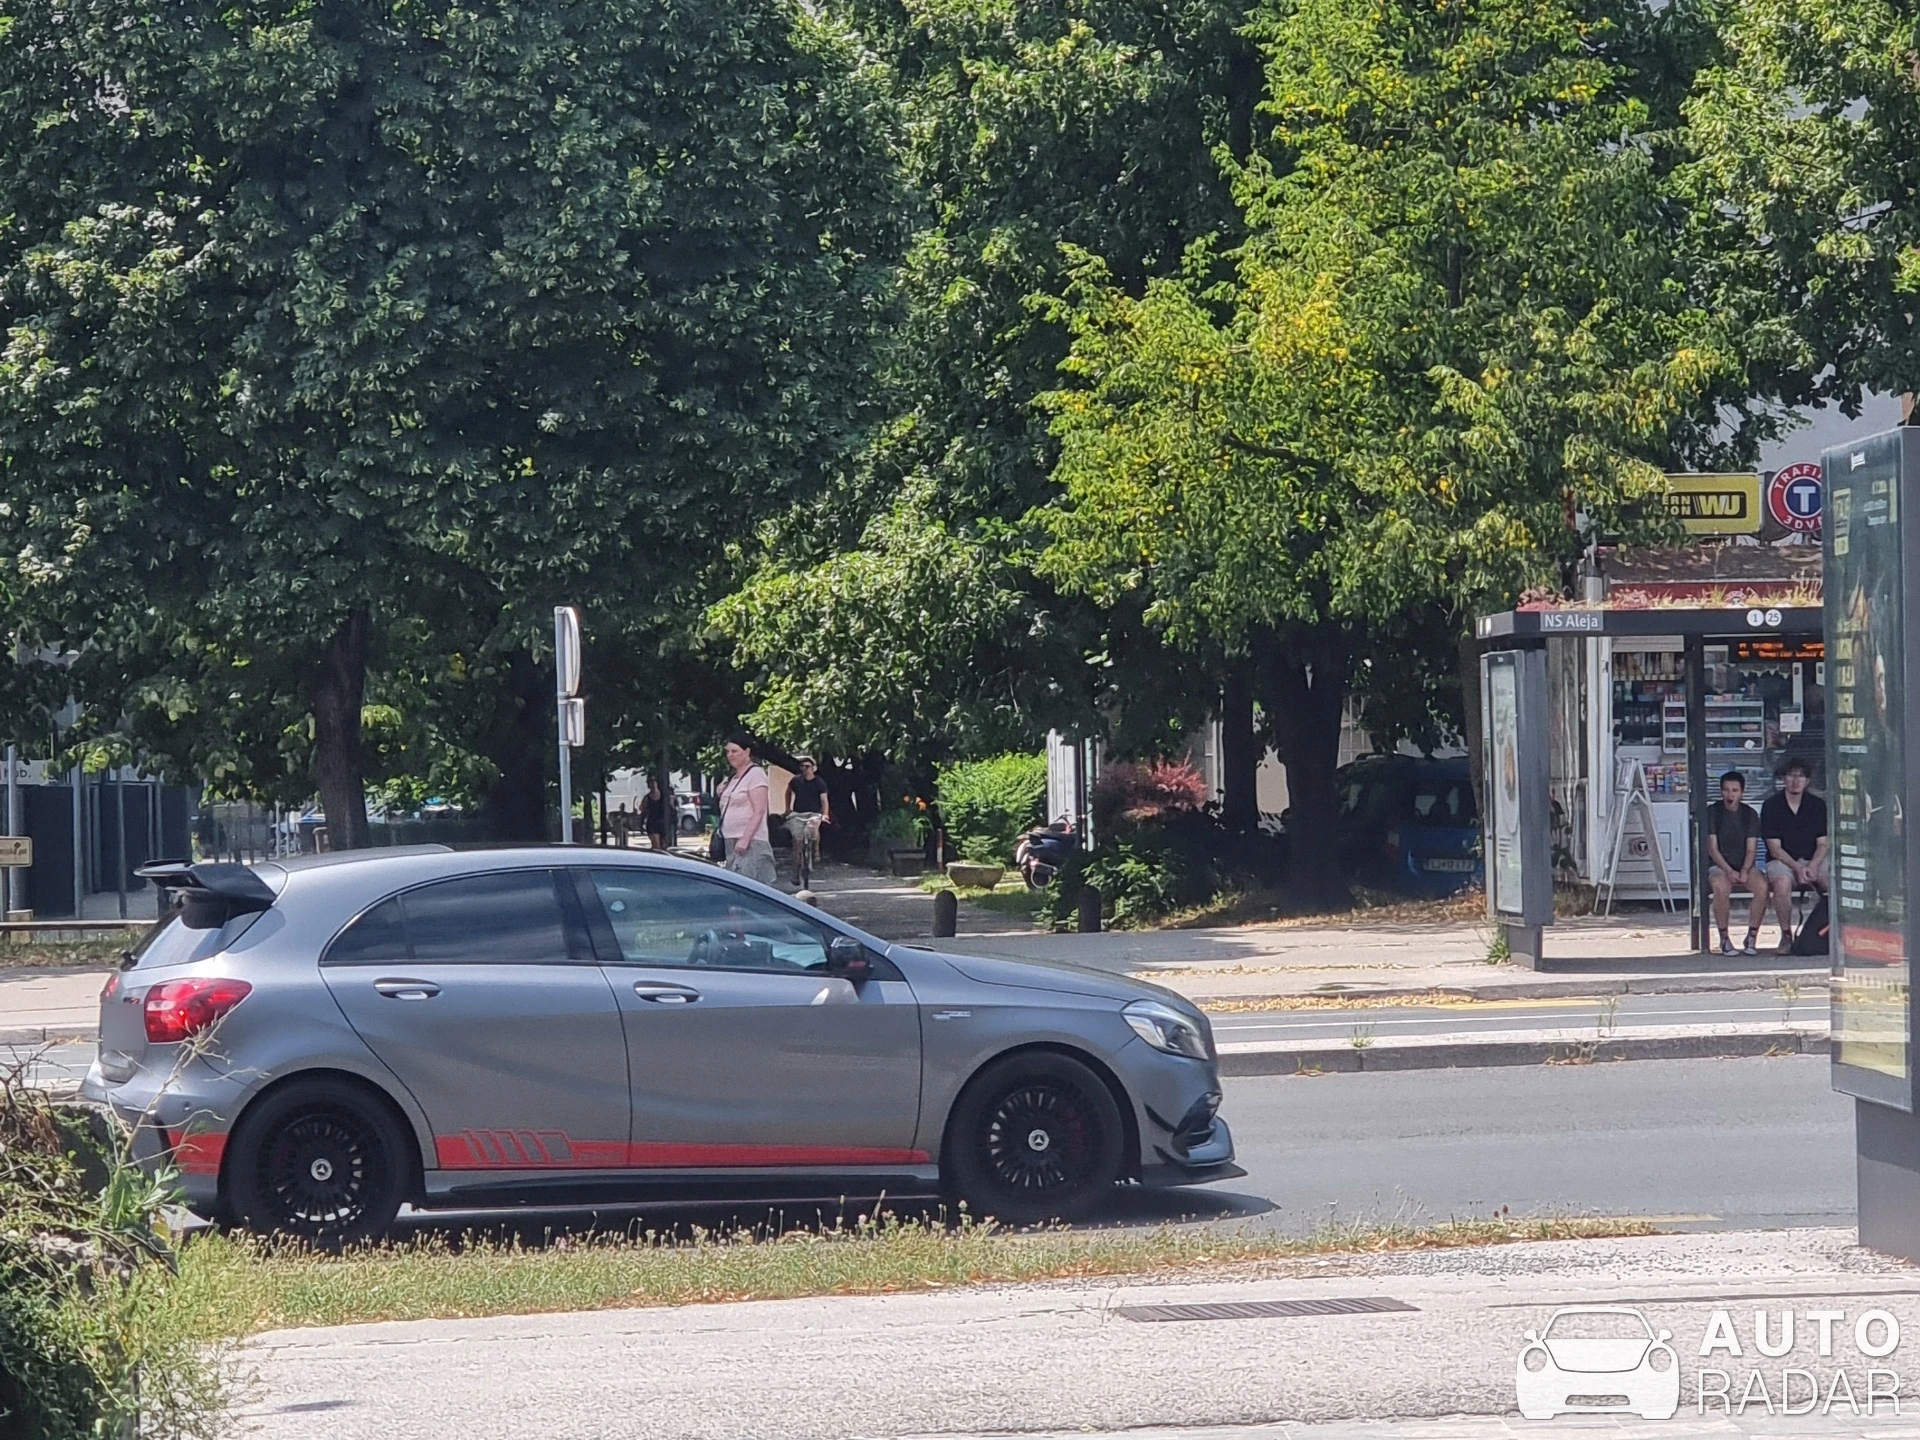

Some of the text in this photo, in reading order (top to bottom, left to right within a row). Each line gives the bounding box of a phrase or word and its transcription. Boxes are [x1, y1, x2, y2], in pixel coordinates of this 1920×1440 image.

[1698, 495, 1741, 515] WU
[1793, 486, 1816, 513] T
[1544, 613, 1598, 630] NS Aleja
[1767, 613, 1779, 623] 25
